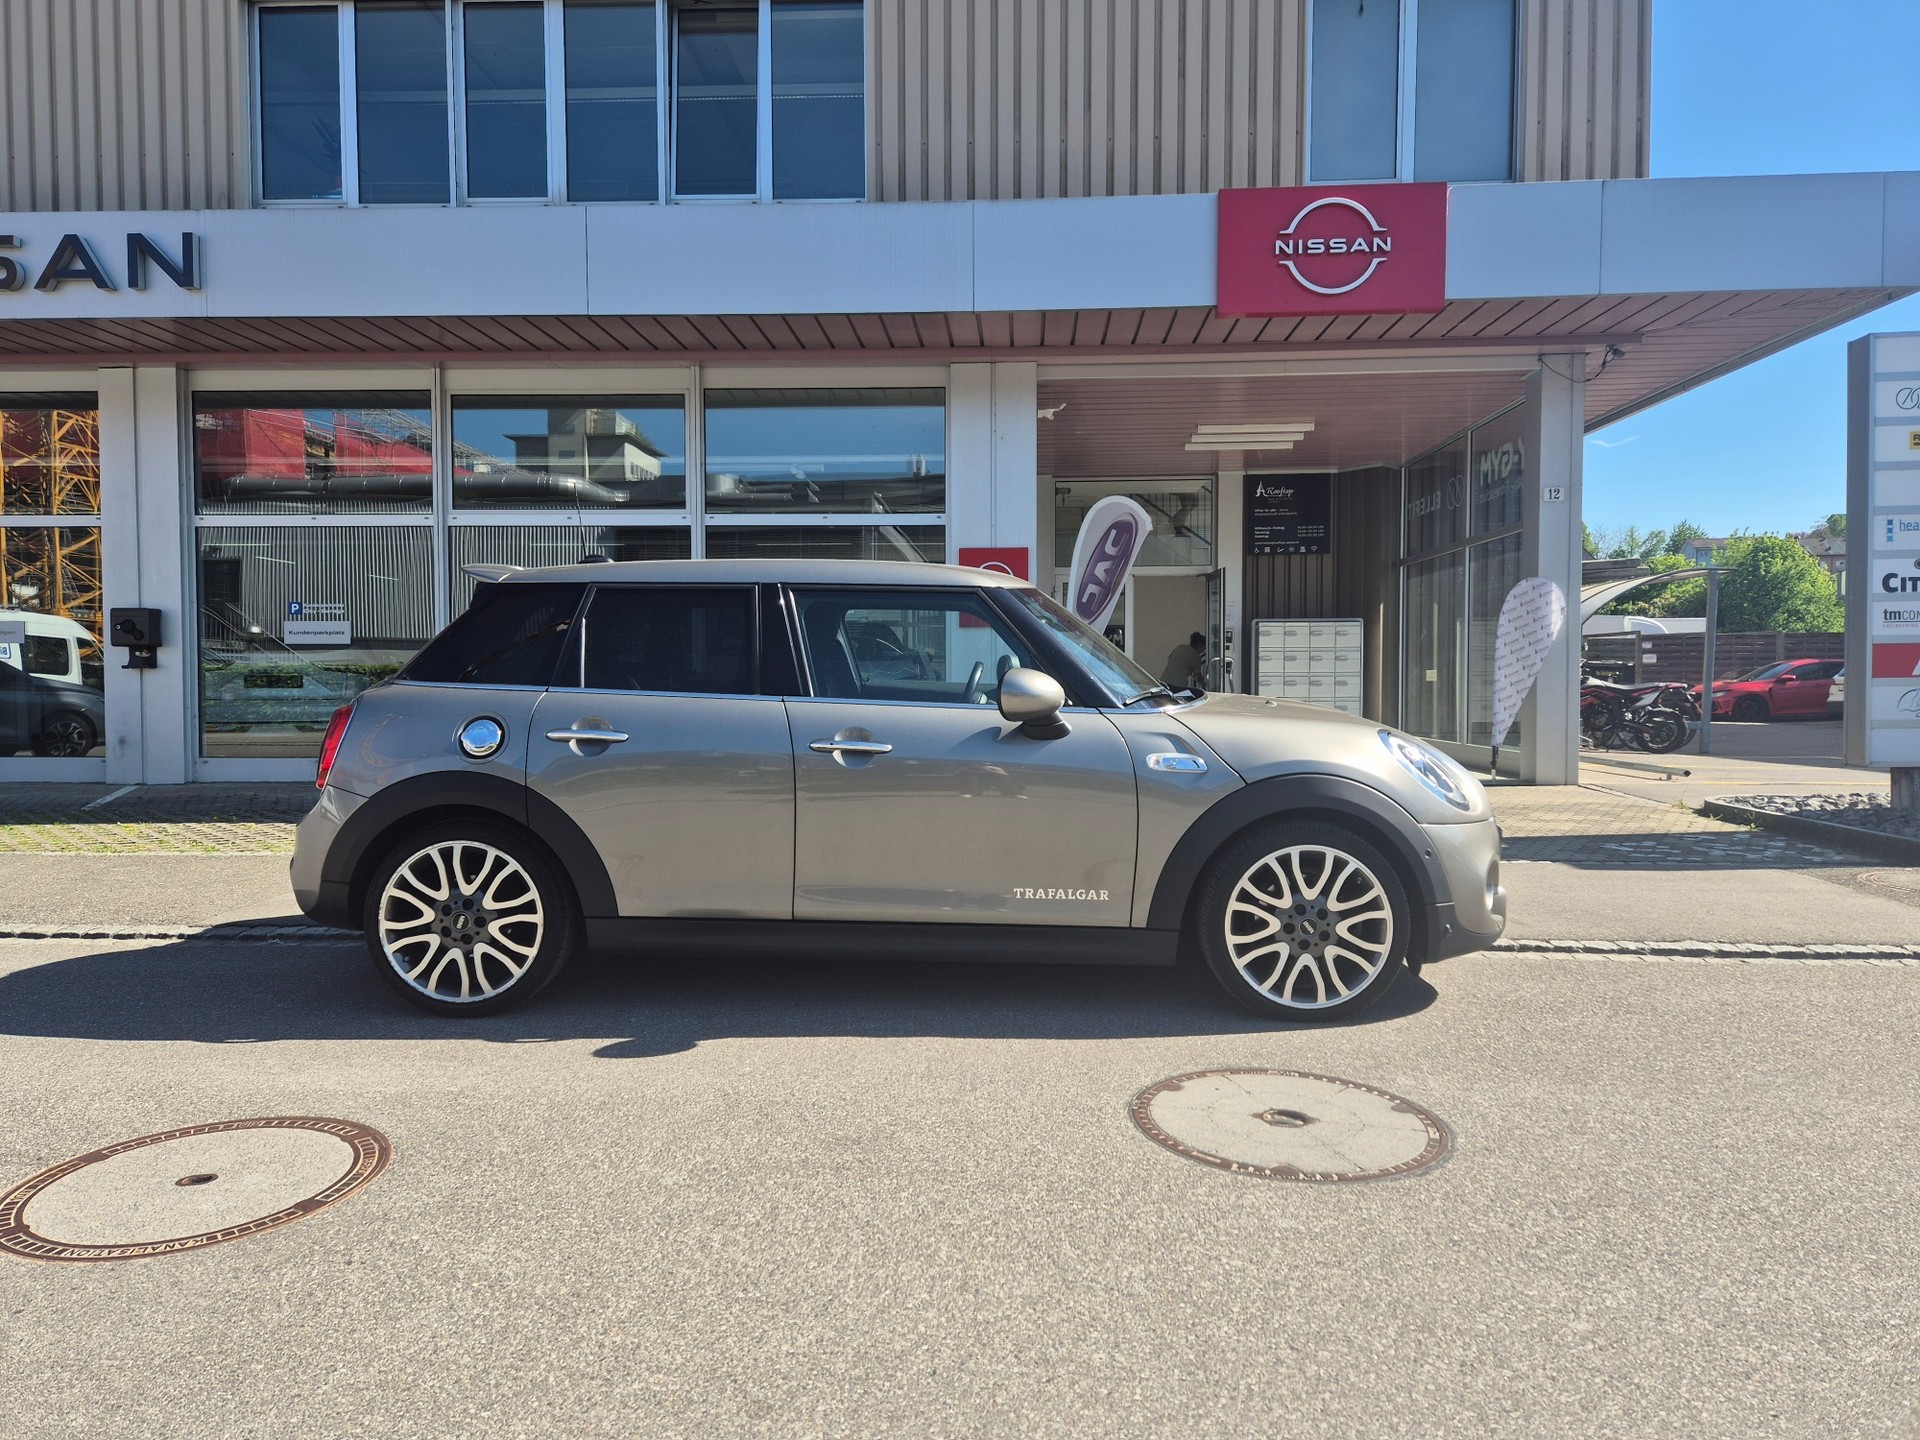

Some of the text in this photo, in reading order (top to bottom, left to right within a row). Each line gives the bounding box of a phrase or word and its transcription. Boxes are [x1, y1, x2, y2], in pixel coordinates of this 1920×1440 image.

[1275, 237, 1392, 255] NISSAN
[1266, 486, 1295, 498] Rooftop
[1548, 488, 1560, 500] 12
[1900, 520, 1920, 531] hea
[291, 603, 300, 614] P
[1013, 887, 1110, 901] TRAFALGAR
[64, 1238, 205, 1258] KANALISATION
